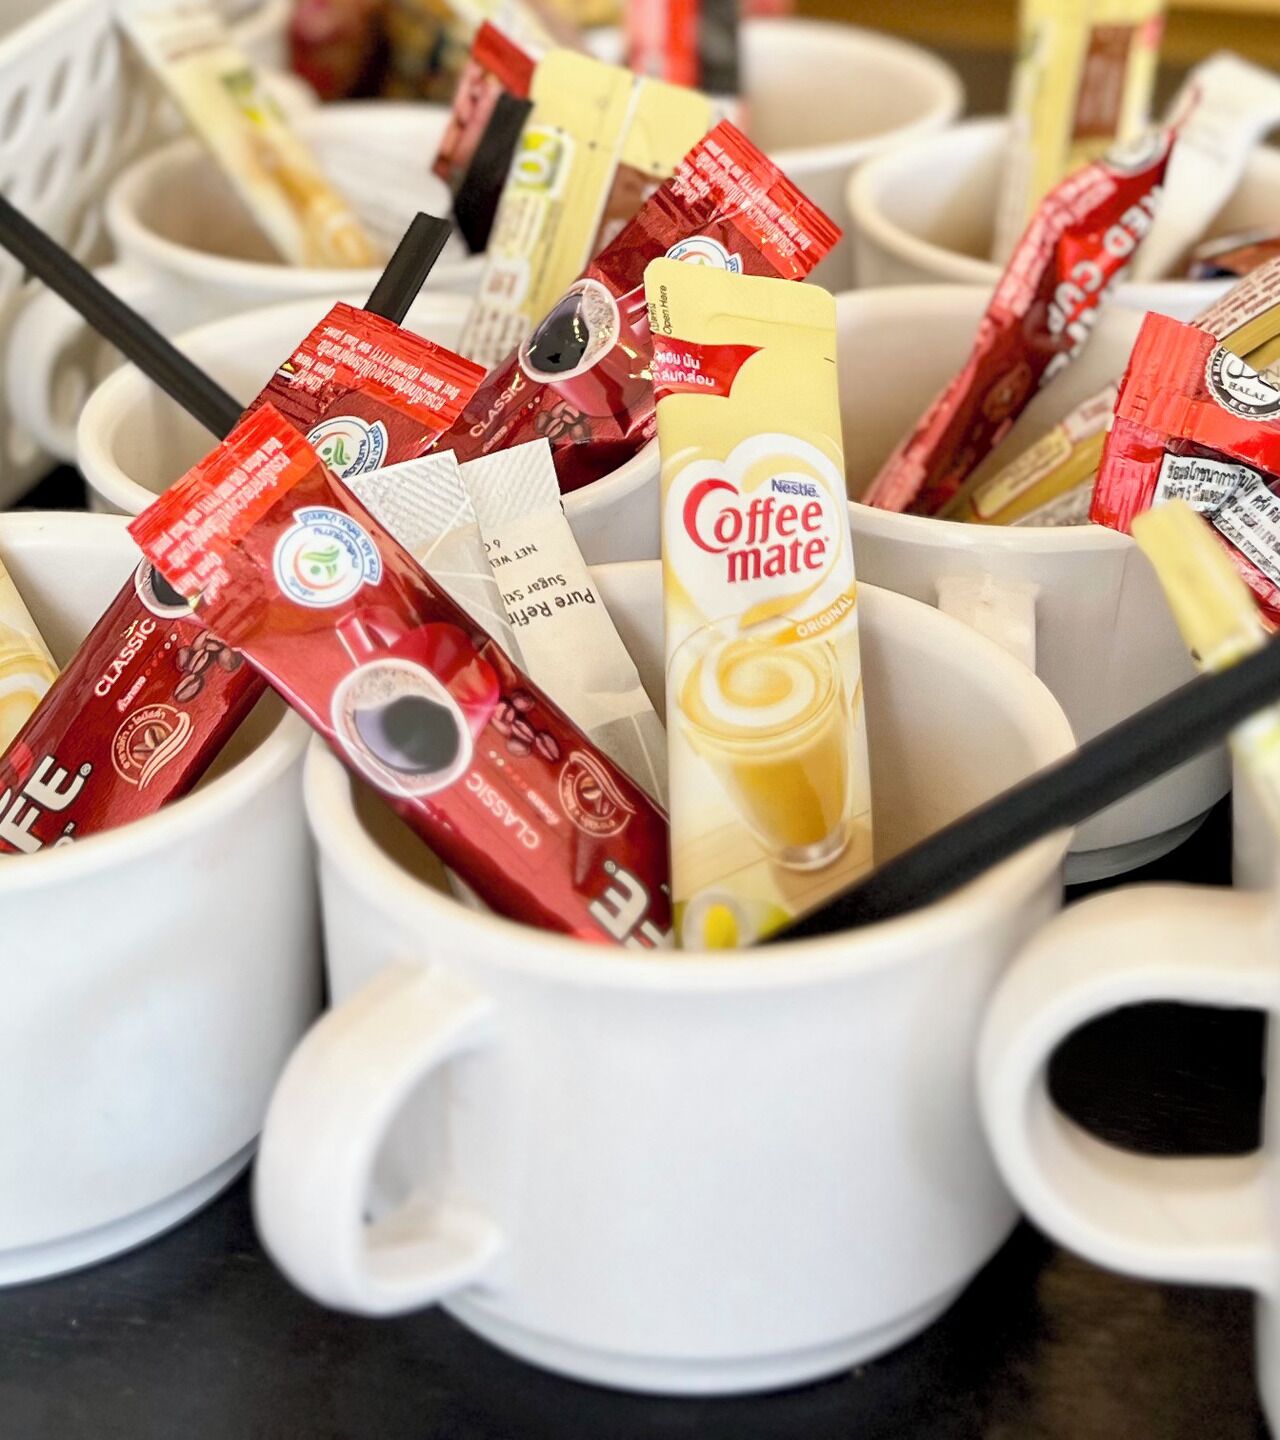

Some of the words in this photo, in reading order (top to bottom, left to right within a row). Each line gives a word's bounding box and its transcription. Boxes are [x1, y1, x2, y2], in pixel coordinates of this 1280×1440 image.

[659, 284, 669, 308] Here
[1047, 258, 1106, 333] CUP
[662, 308, 672, 334] Open
[312, 361, 335, 379] Open
[419, 372, 444, 392] Before
[441, 383, 460, 400] Best
[1228, 380, 1267, 402] HALAL
[468, 376, 526, 438] CLASSIC
[682, 477, 823, 553] Coffee
[513, 543, 538, 558] NET
[726, 535, 825, 584] mate
[526, 573, 566, 593] Sugar
[553, 587, 595, 607] Pure
[797, 594, 855, 641] ORIGINAL
[92, 614, 159, 699] CLASSIC
[466, 772, 540, 850] CLASSIC
